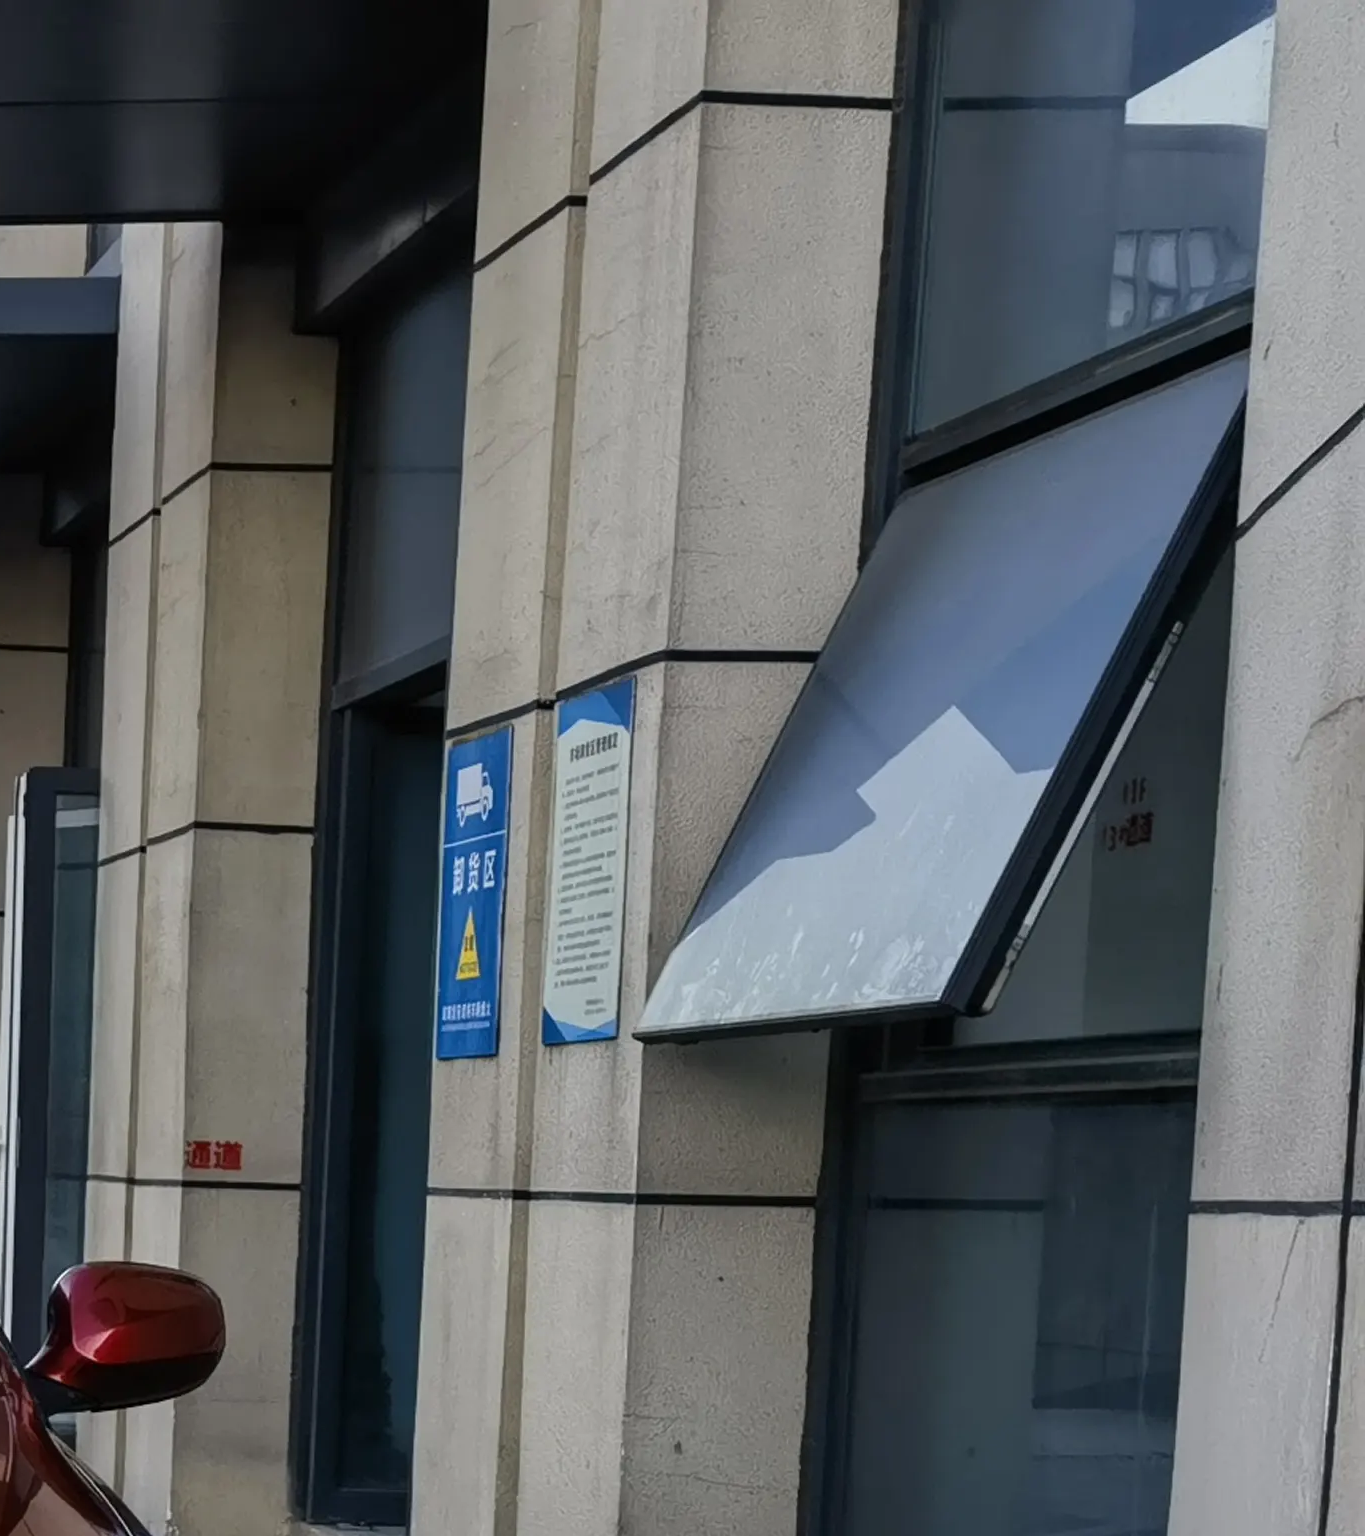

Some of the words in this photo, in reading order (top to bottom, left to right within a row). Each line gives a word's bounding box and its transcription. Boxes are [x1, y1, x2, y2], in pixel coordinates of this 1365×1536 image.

[452, 850, 495, 895] 卸货区
[185, 1141, 243, 1170] 通道
